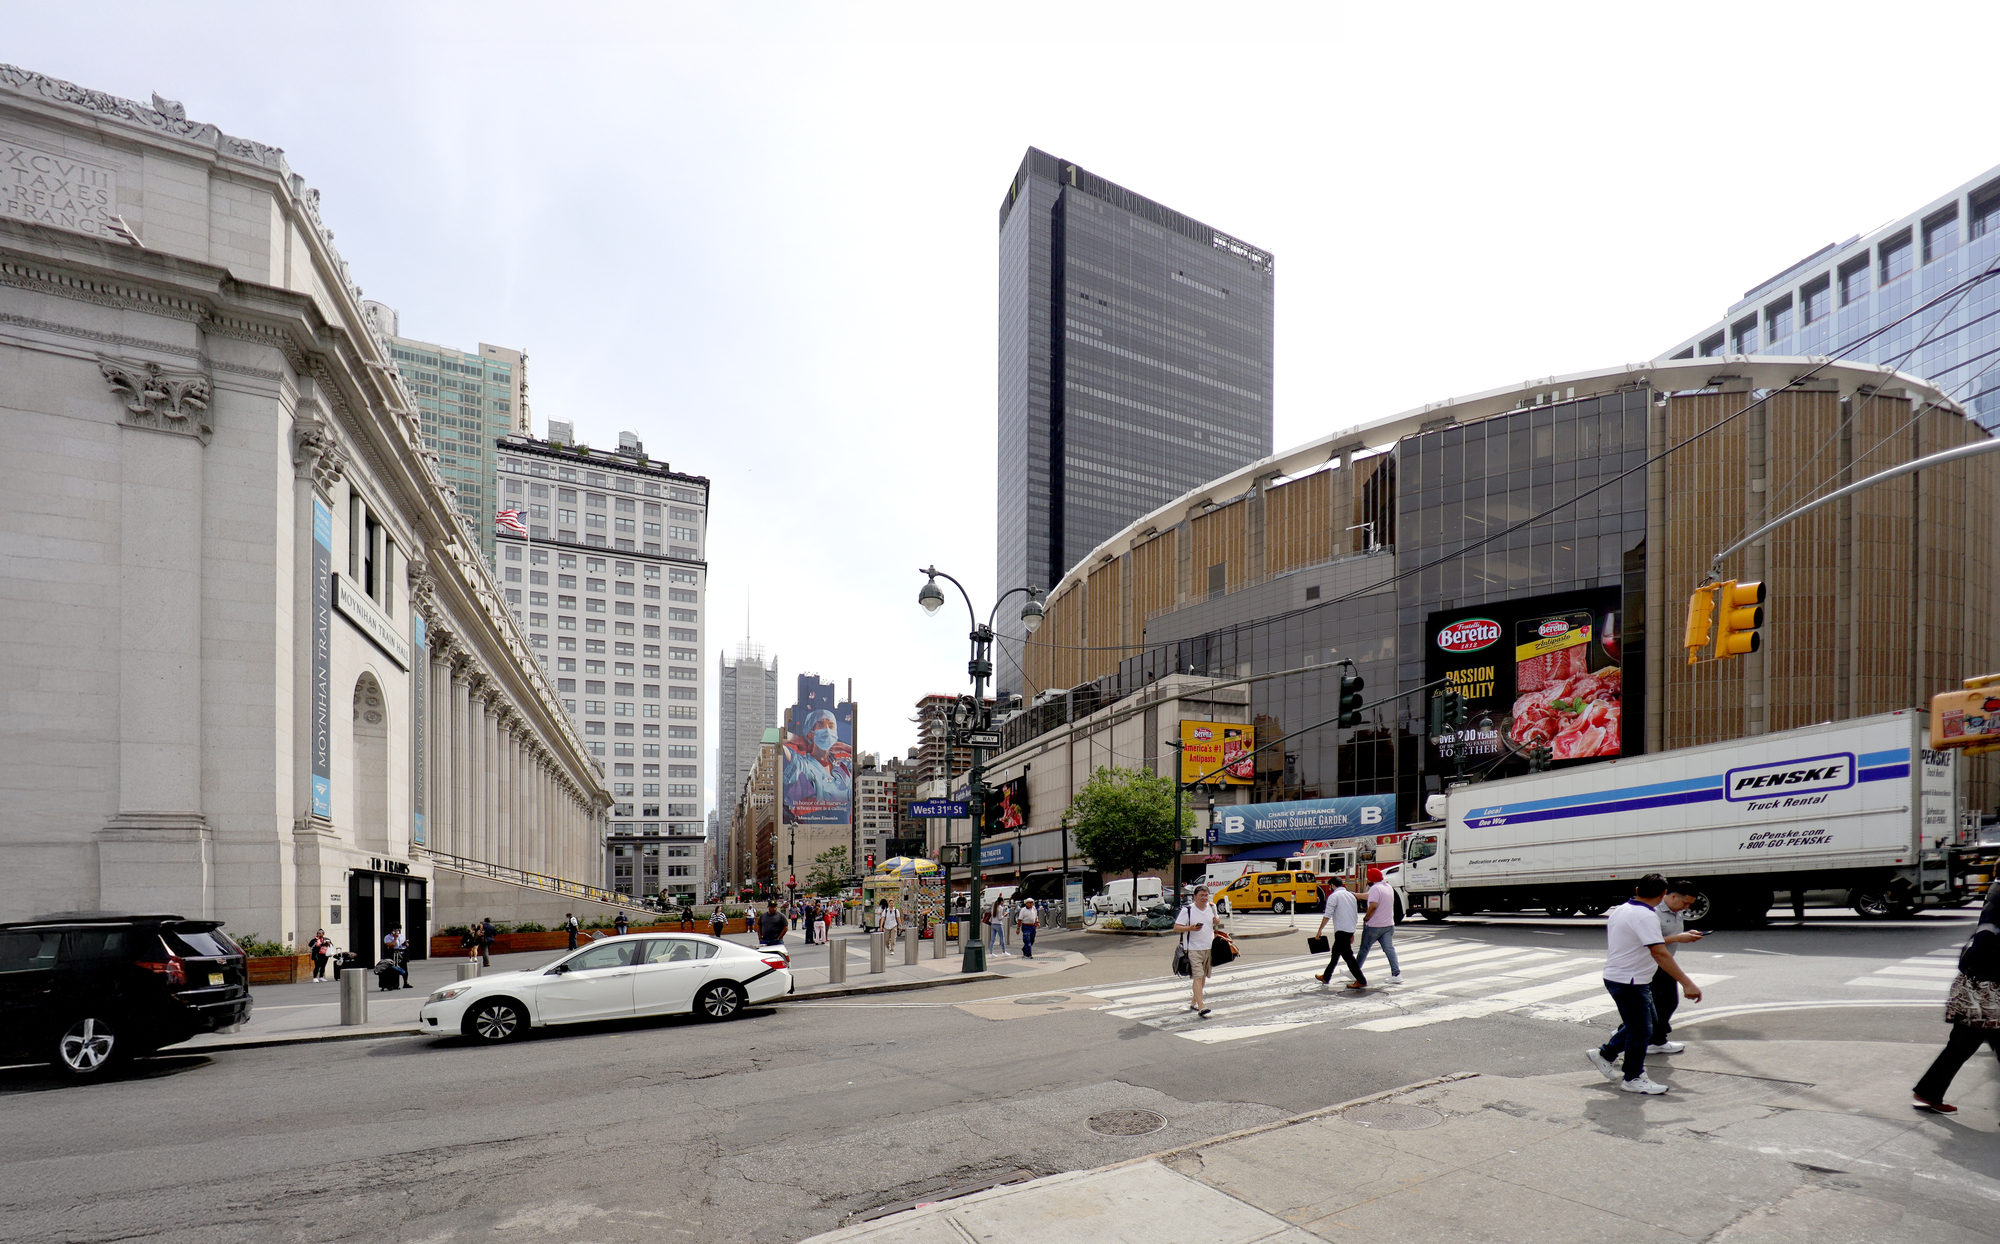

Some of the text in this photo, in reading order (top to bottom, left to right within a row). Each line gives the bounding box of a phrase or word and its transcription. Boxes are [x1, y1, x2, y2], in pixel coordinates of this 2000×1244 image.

[1065, 164, 1077, 188] 1
[11, 166, 108, 205] TAXES
[1010, 180, 1017, 201] 1
[13, 184, 109, 221] RELAYS
[6, 199, 108, 237] FRANCE
[340, 587, 377, 630] MOYNIHAN
[378, 624, 396, 648] TRAIN
[396, 643, 409, 661] HALL
[1540, 624, 1568, 635] Beretta
[1441, 625, 1498, 647] Beretta
[318, 558, 327, 768] MOYNIHAN TRAIN HALL
[1446, 666, 1495, 685] PASSION
[1184, 743, 1221, 753] America's #1
[1189, 754, 1216, 764] Antipasto
[1922, 749, 1952, 767] PENSKE
[1734, 765, 1845, 791] PENSKE
[913, 805, 962, 815] West 31st St
[1747, 794, 1829, 811] Truck Rental
[1225, 816, 1245, 833] B
[1297, 808, 1336, 816] ENTRANCE
[1361, 806, 1382, 824] B
[1484, 807, 1503, 816] Local
[1255, 814, 1348, 830] MADISON SQUARE GARDEN
[1479, 817, 1507, 827] One Way
[1738, 835, 1834, 851] 1-800-GO-PENSKE
[1749, 829, 1825, 841] GoPenske.com
[987, 848, 1002, 857] THEATER
[370, 857, 381, 871] TO
